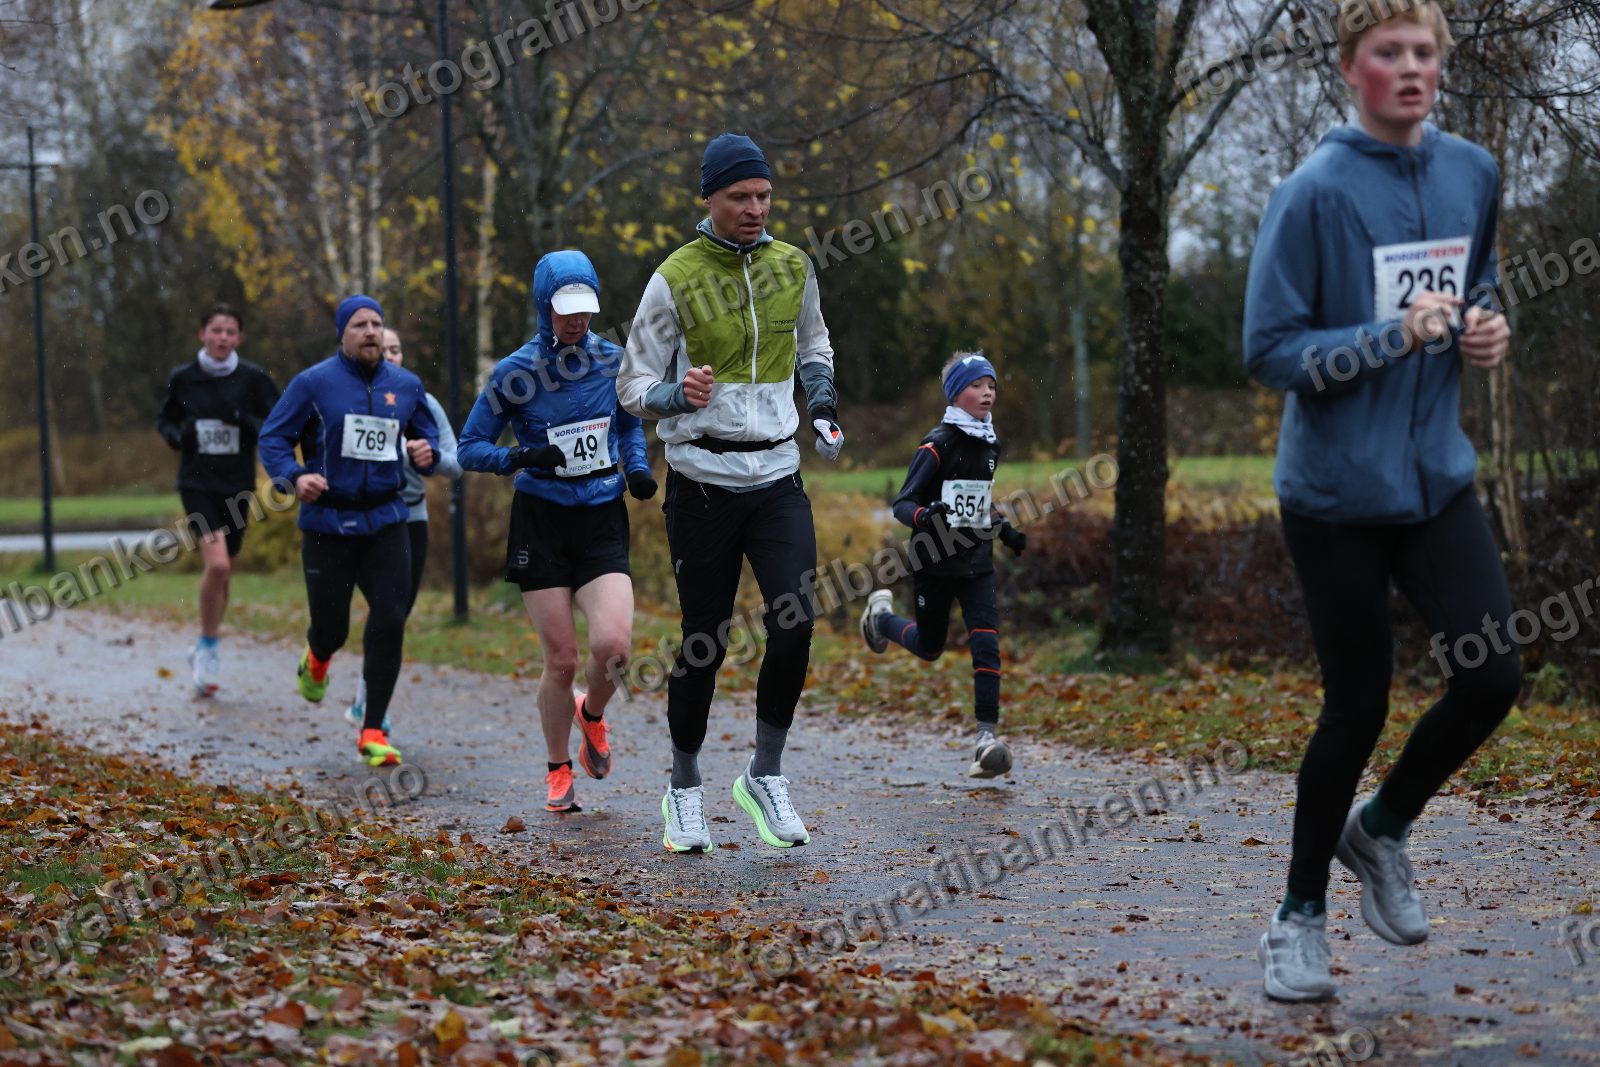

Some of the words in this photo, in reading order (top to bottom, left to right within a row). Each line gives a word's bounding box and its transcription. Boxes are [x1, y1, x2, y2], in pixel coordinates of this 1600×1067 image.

[355, 428, 386, 451] 769
[573, 434, 598, 462] 49
[954, 494, 985, 518] 654
